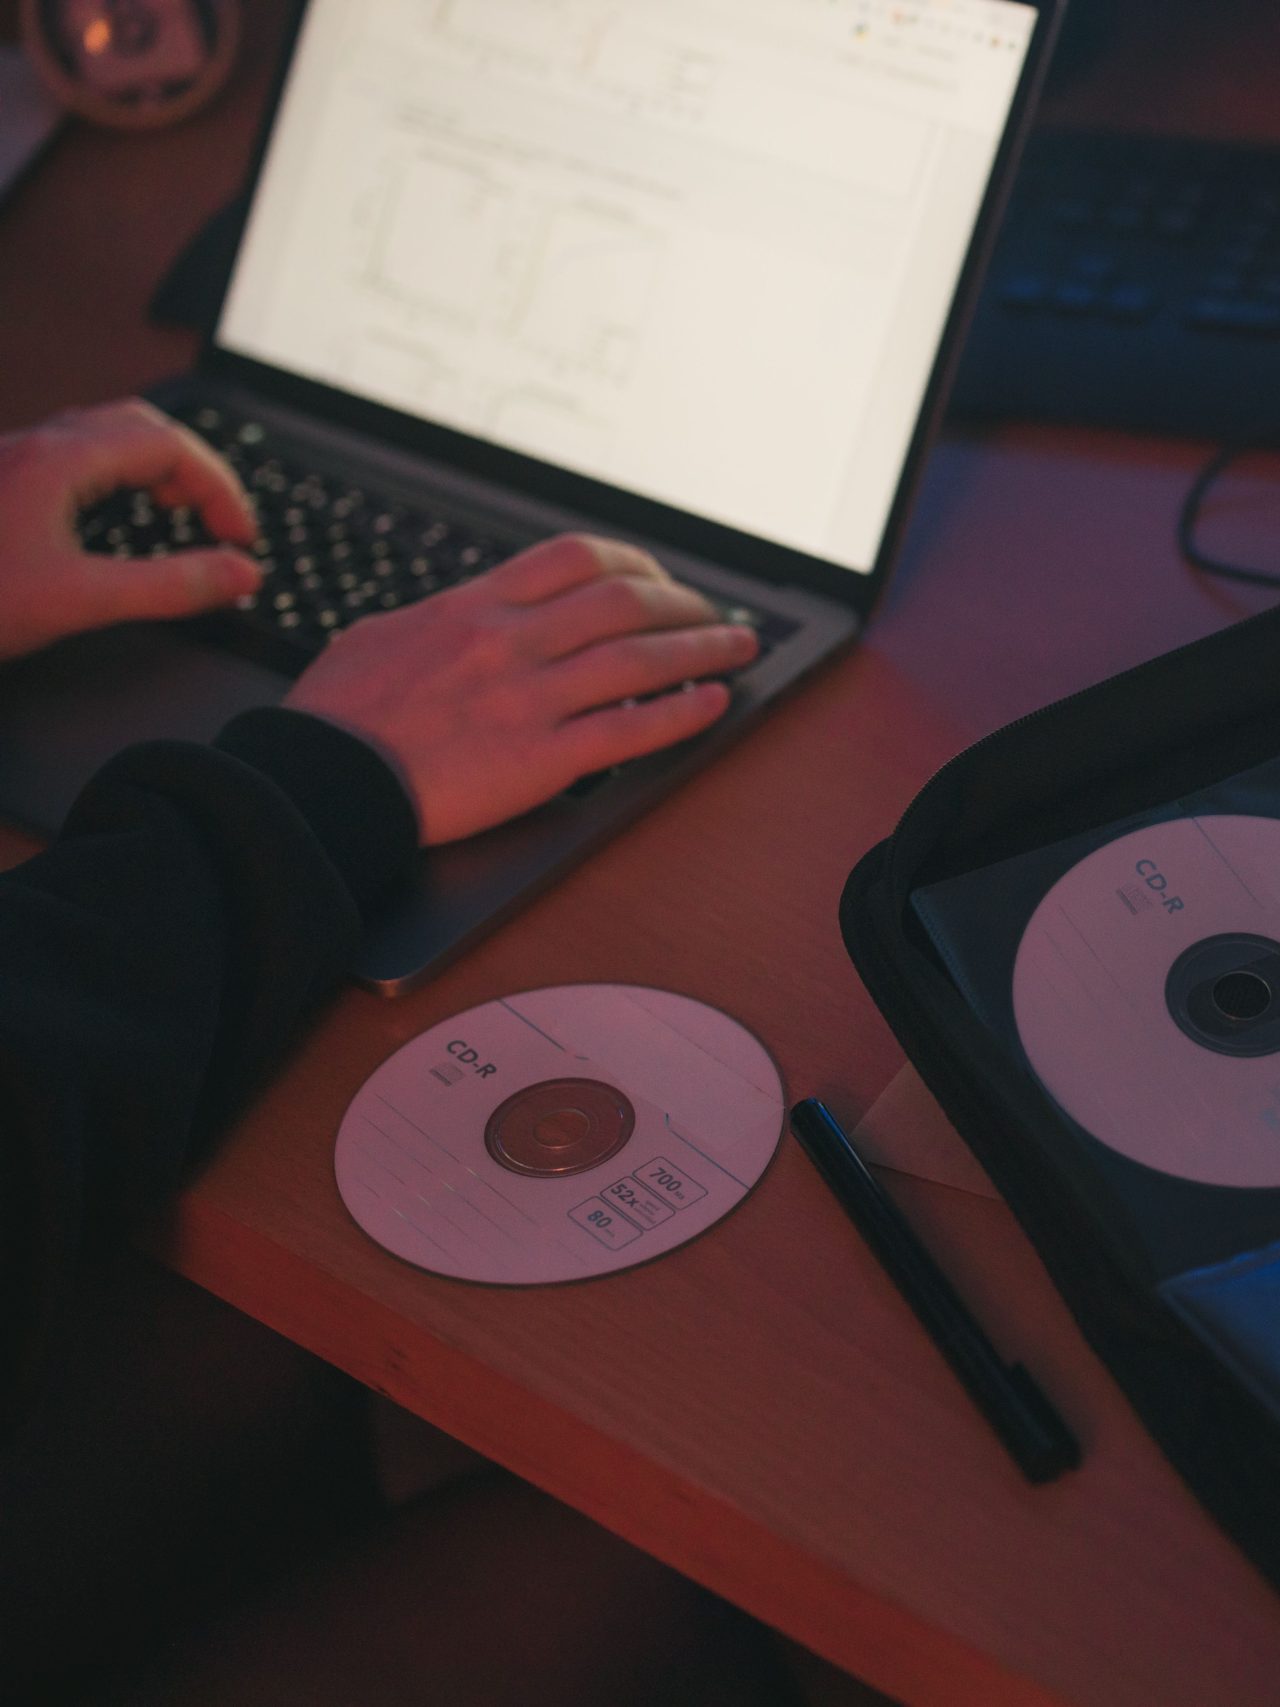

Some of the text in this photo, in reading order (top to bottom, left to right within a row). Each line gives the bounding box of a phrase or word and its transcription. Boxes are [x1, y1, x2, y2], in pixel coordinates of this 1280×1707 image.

[1136, 859, 1184, 914] CD-R
[446, 1040, 497, 1079] CD-R
[649, 1167, 683, 1192] 700
[610, 1183, 641, 1207] 52x
[587, 1210, 613, 1229] 80
